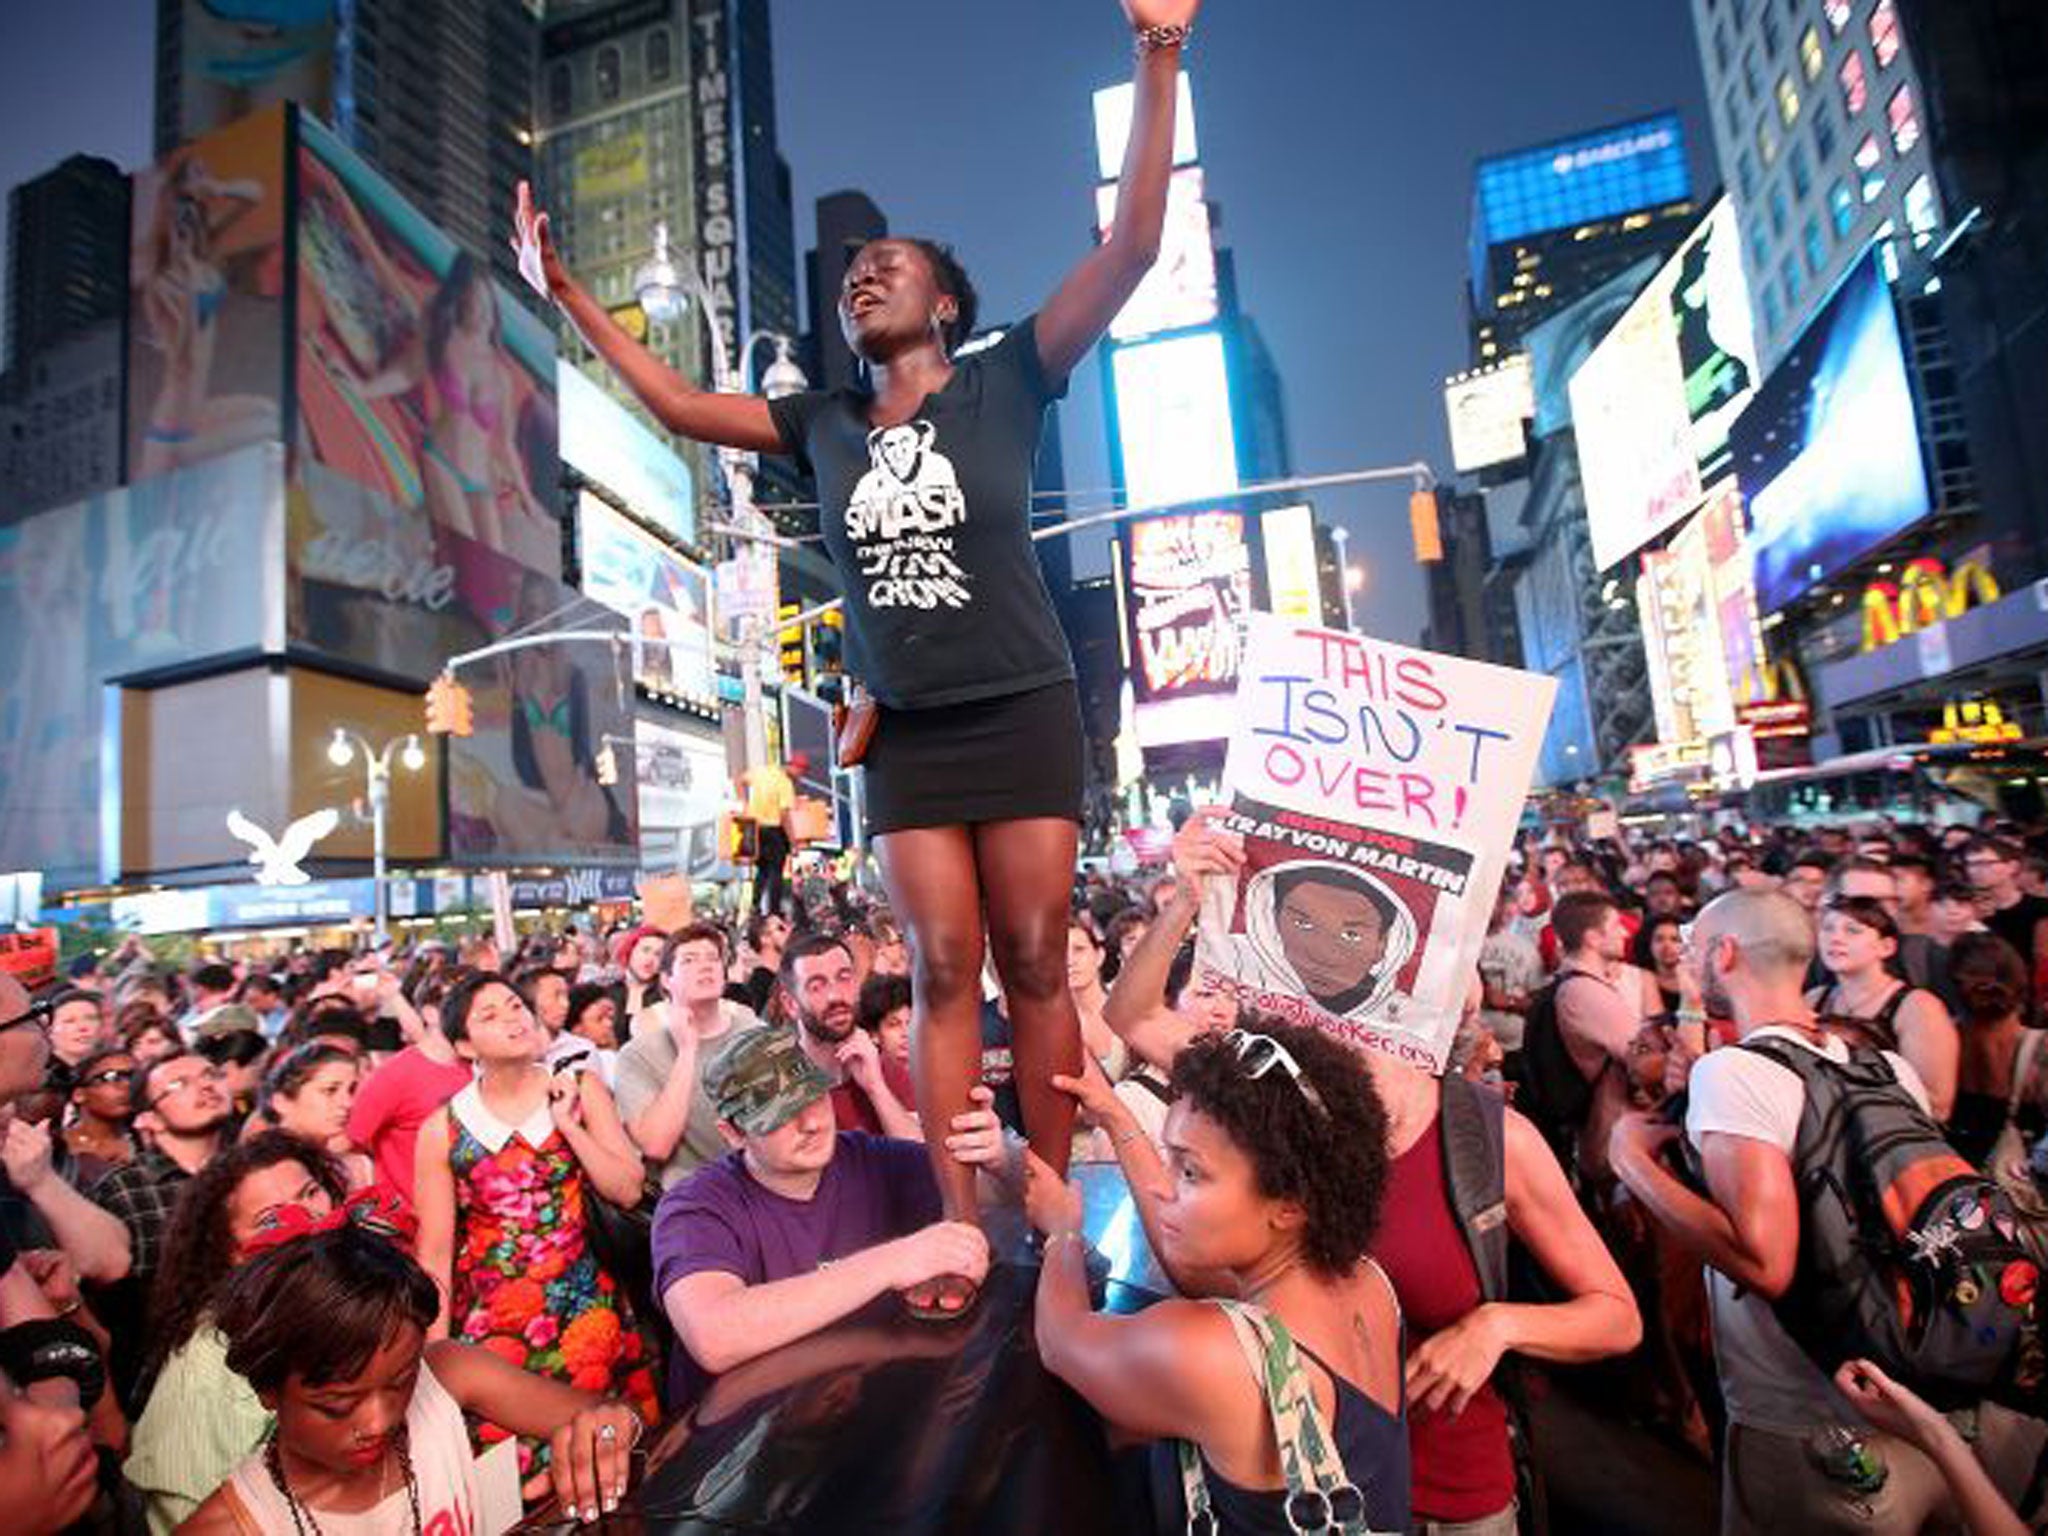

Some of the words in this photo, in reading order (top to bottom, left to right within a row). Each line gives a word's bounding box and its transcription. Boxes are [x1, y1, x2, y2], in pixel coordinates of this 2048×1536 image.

[694, 12, 728, 167] TIMES
[844, 487, 966, 541] SMASH
[861, 552, 966, 578] JIM
[867, 577, 972, 610] CROW
[1294, 630, 1448, 712] THIS
[1252, 675, 1512, 784] ISN'T
[1264, 743, 1468, 830] OVER!
[1226, 814, 1349, 858] TRAYVON
[1350, 846, 1466, 892] MARTIN
